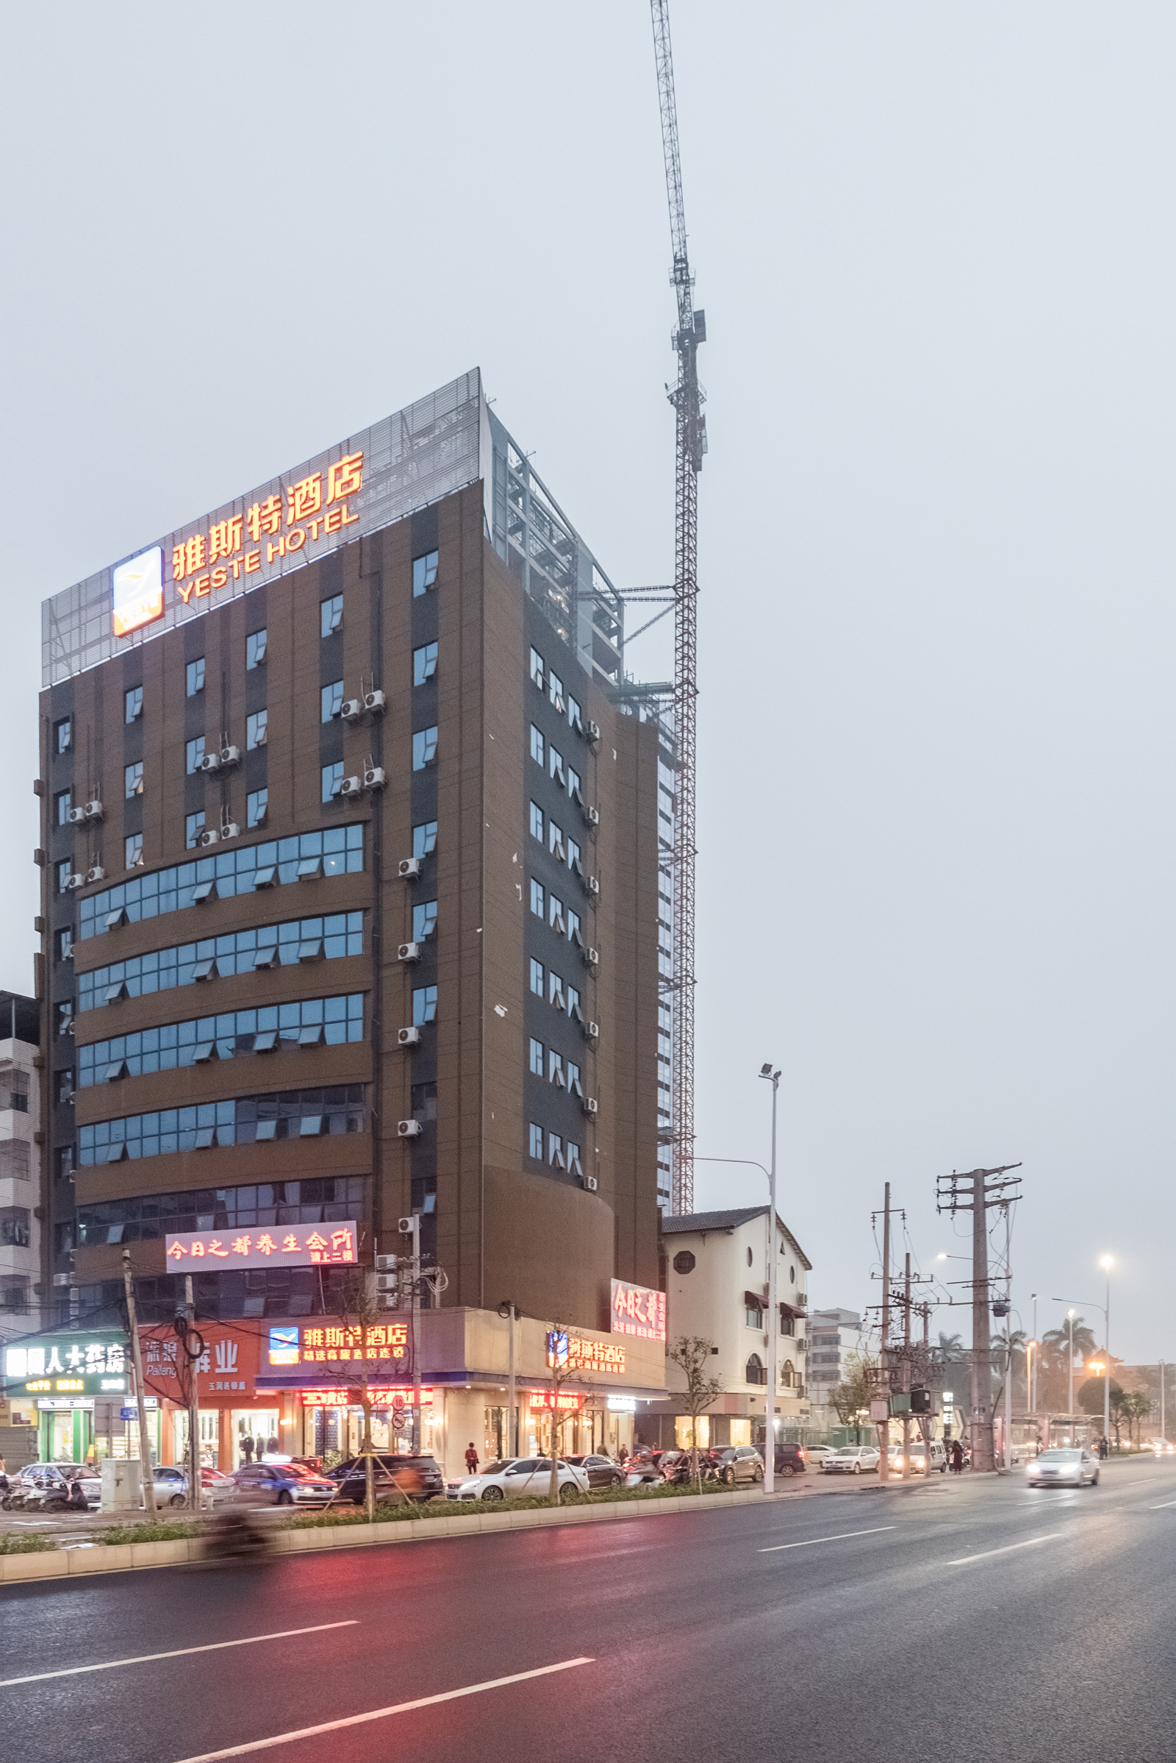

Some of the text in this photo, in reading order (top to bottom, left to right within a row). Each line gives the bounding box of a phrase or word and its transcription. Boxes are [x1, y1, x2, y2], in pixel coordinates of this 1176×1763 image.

[171, 450, 364, 582] 雅斯特酒店
[177, 504, 360, 604] YESTE HOTEL
[166, 1227, 353, 1261] 今日之都养生会所
[310, 1250, 353, 1264] 请上二楼
[614, 1283, 657, 1329] 今日之都
[303, 1323, 408, 1348] 雅斯特酒店
